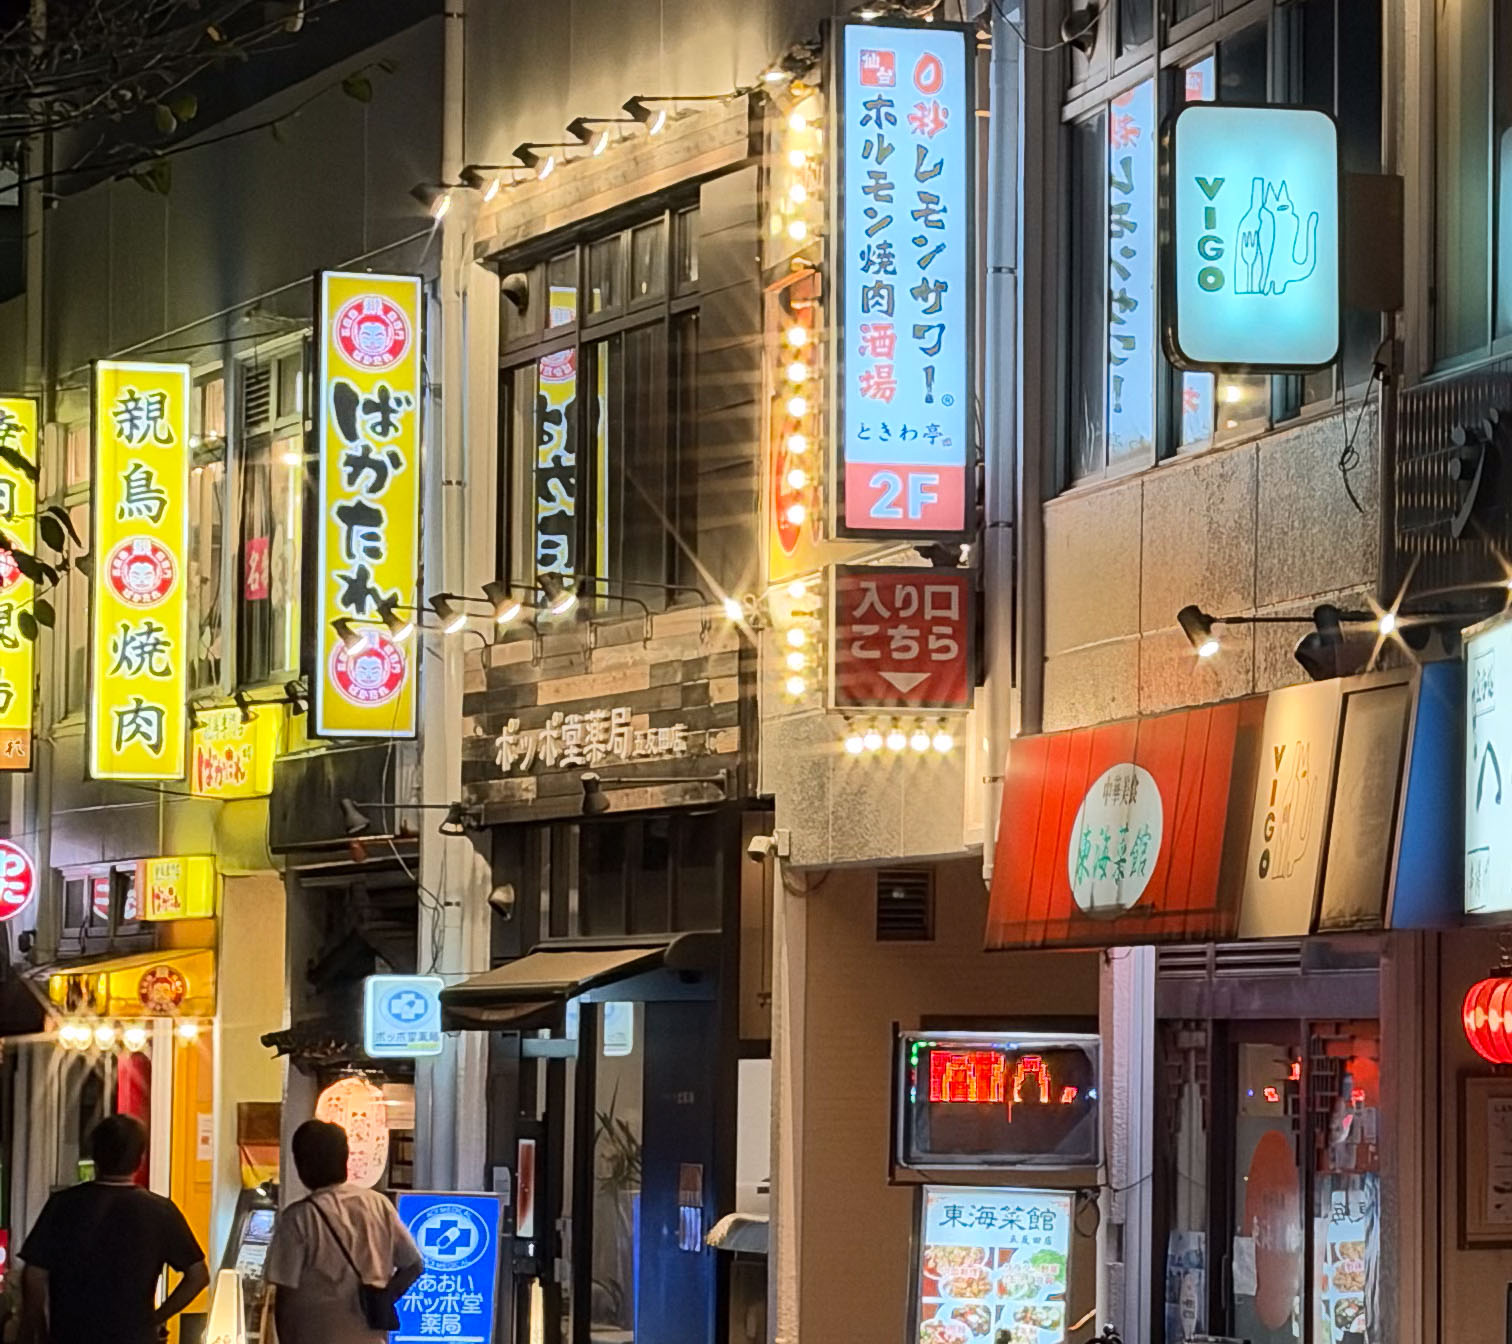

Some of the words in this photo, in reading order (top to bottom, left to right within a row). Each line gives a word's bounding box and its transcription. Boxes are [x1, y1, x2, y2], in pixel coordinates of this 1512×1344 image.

[1194, 177, 1225, 293] VIGO
[857, 422, 943, 445] ときわ亭
[112, 390, 174, 524] 親鳥
[333, 382, 411, 614] ばかたれ
[869, 469, 941, 521] 2F
[852, 581, 960, 620] 入り口
[851, 624, 959, 661] こちら
[108, 621, 172, 755] 焼肉
[1258, 745, 1286, 879] VIGO
[939, 1204, 1056, 1232] 東海菜館
[417, 1273, 474, 1293] あおい
[403, 1293, 484, 1315] ポッポ堂
[420, 1314, 462, 1336] 薬局
